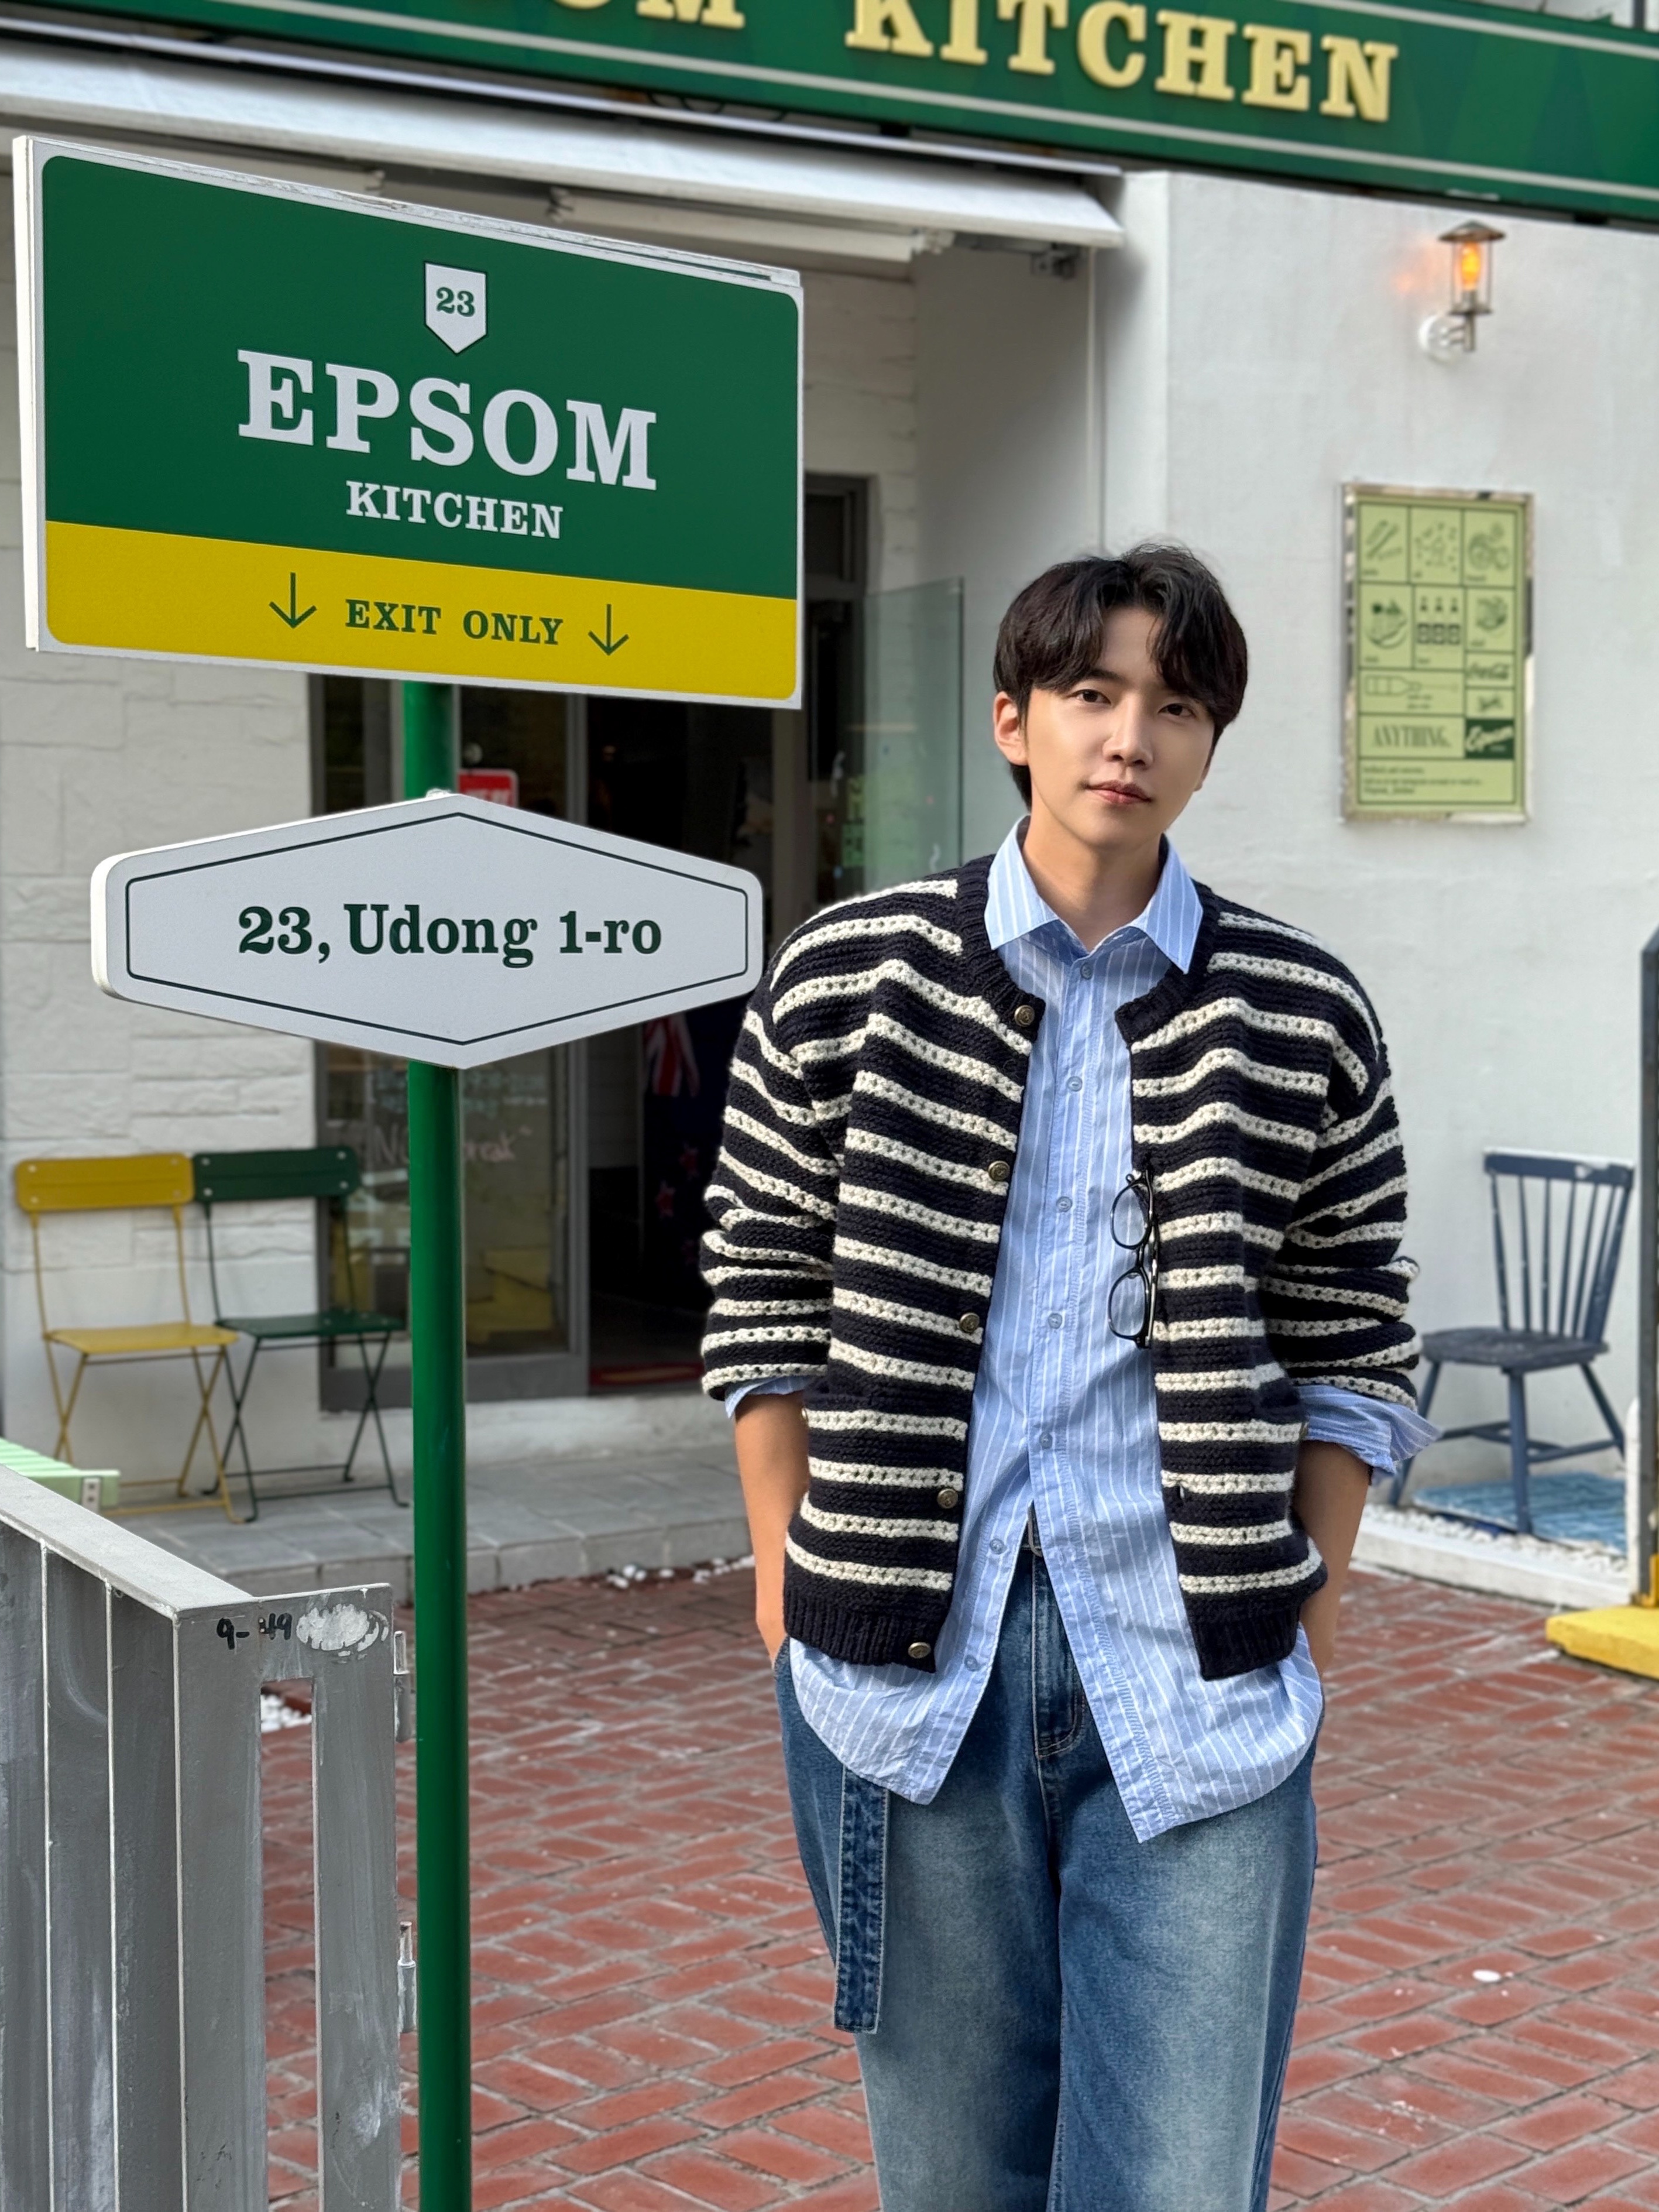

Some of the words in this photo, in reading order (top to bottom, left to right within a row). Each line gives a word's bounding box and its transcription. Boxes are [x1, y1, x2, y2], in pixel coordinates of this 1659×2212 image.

[846, 0, 1399, 122] KITCHEN
[435, 286, 476, 318] 23
[237, 349, 657, 491] EPSOM
[346, 480, 564, 539] KITCHEN
[345, 598, 441, 635] EXIT
[463, 609, 564, 645] ONLY
[239, 906, 331, 963] 23,
[344, 903, 538, 969] Udong
[559, 910, 661, 955] 1-ro
